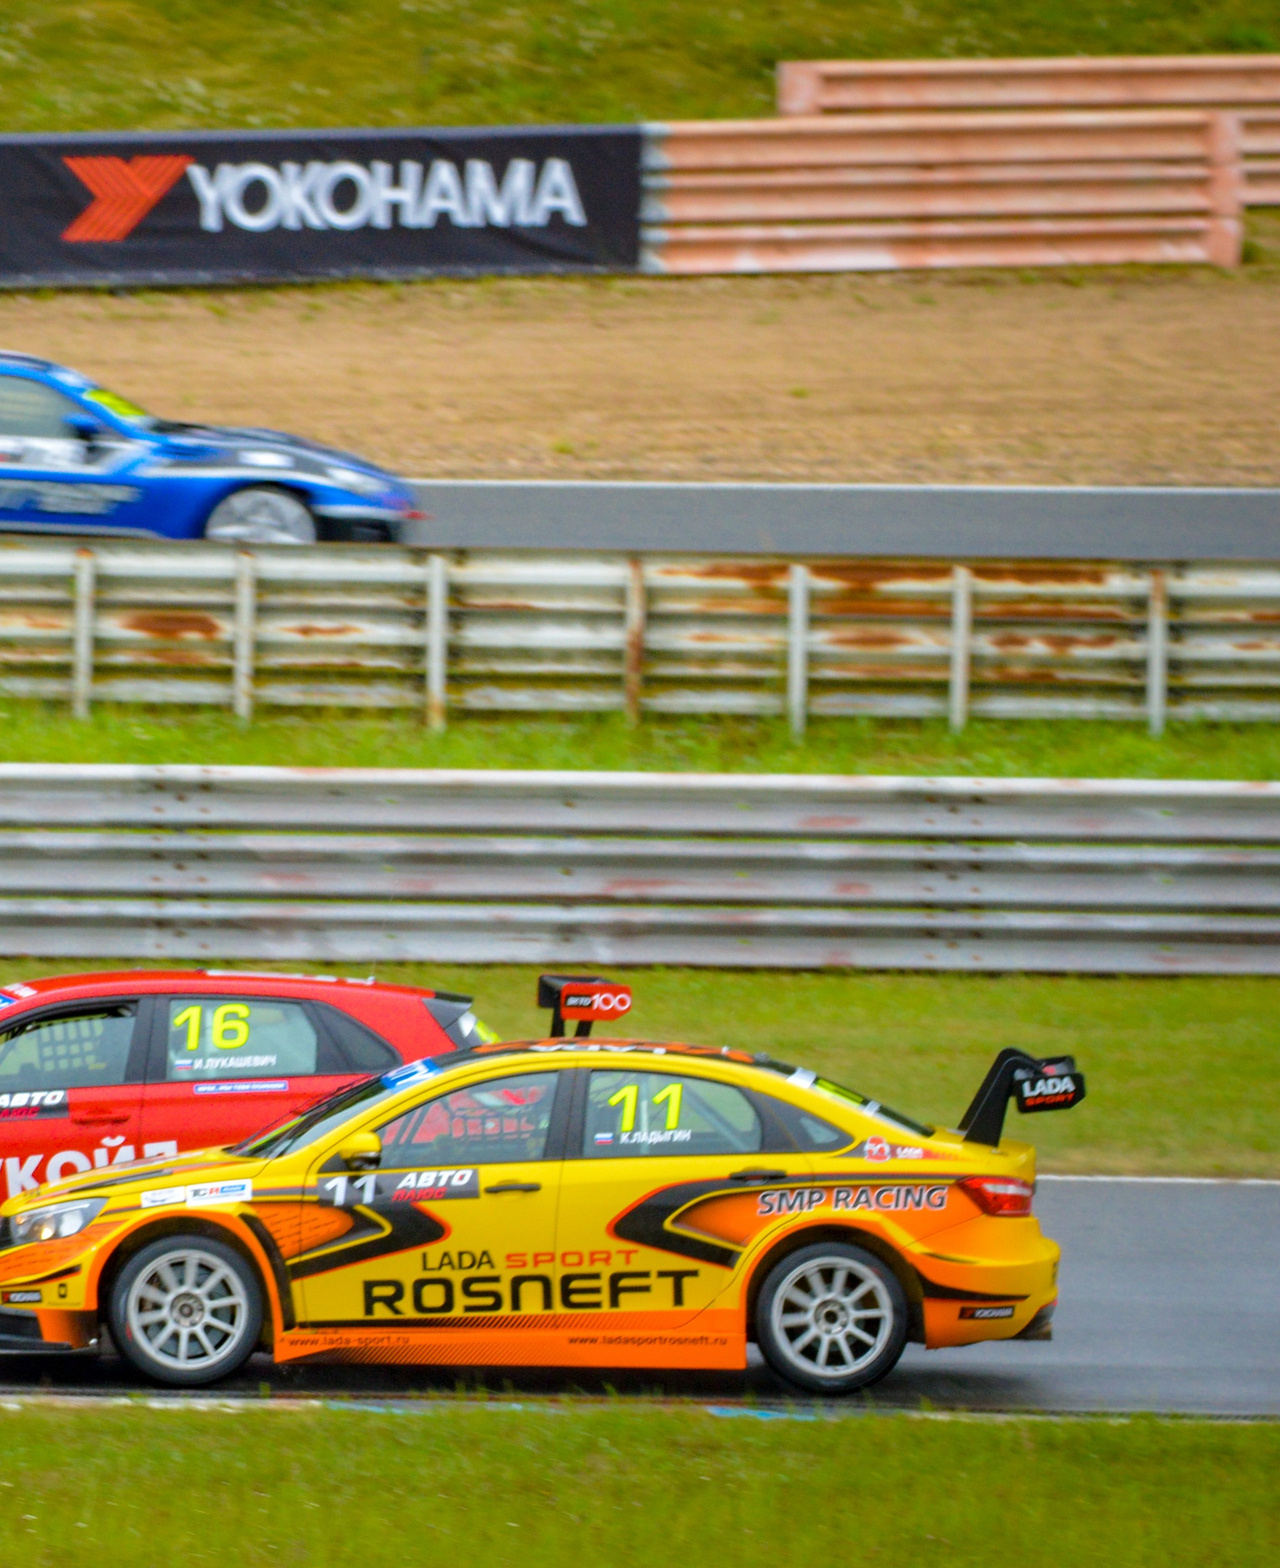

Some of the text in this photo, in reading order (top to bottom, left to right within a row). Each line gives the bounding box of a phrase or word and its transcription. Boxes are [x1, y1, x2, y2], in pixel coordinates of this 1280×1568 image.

[186, 158, 587, 232] YOKOHAMA
[173, 1003, 251, 1051] 16
[1022, 1076, 1076, 1098] LADA
[1025, 1092, 1076, 1107] SPORT
[608, 1083, 683, 1132] 11
[324, 1174, 377, 1207] 11
[395, 1169, 473, 1190] АВТО
[757, 1185, 949, 1216] SMP RACING
[422, 1249, 640, 1271] LADA SPORT
[363, 1269, 699, 1317] ROSNEFT
